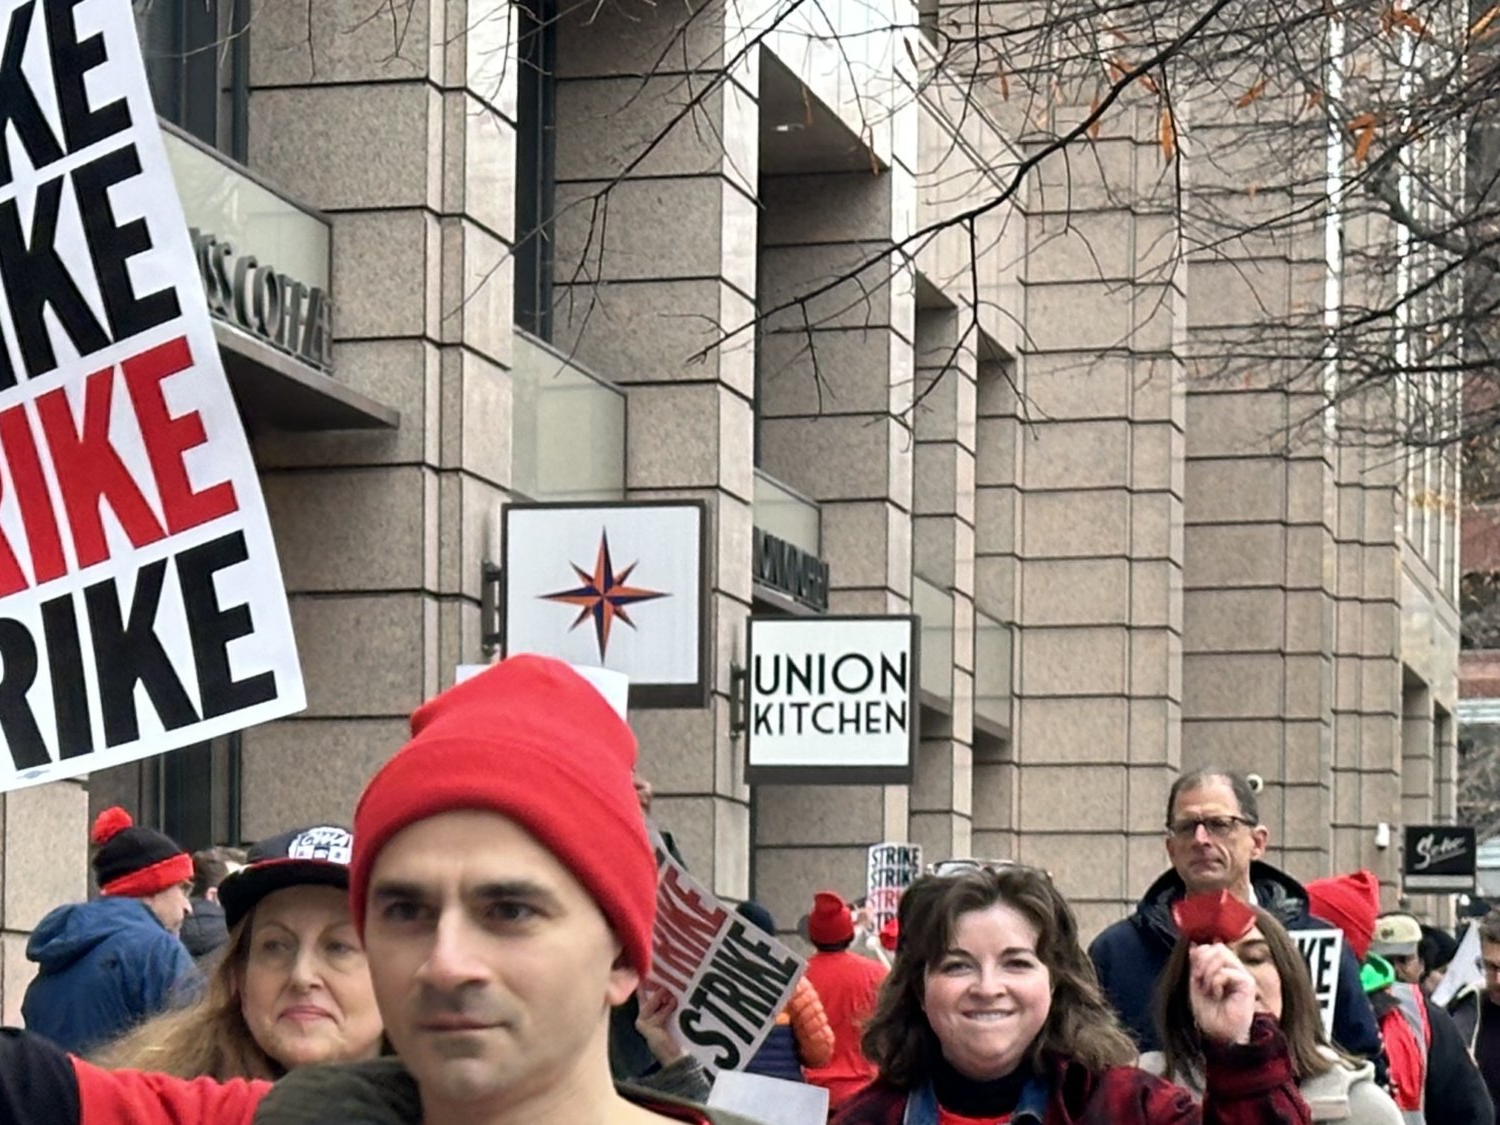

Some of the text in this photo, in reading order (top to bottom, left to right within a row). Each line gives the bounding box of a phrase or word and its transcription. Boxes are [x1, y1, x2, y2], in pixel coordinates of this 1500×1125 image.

[754, 651, 907, 696] UNION
[754, 700, 907, 736] KITCHEN
[871, 846, 920, 869] STRIKE
[679, 920, 799, 1070] STRIKE
